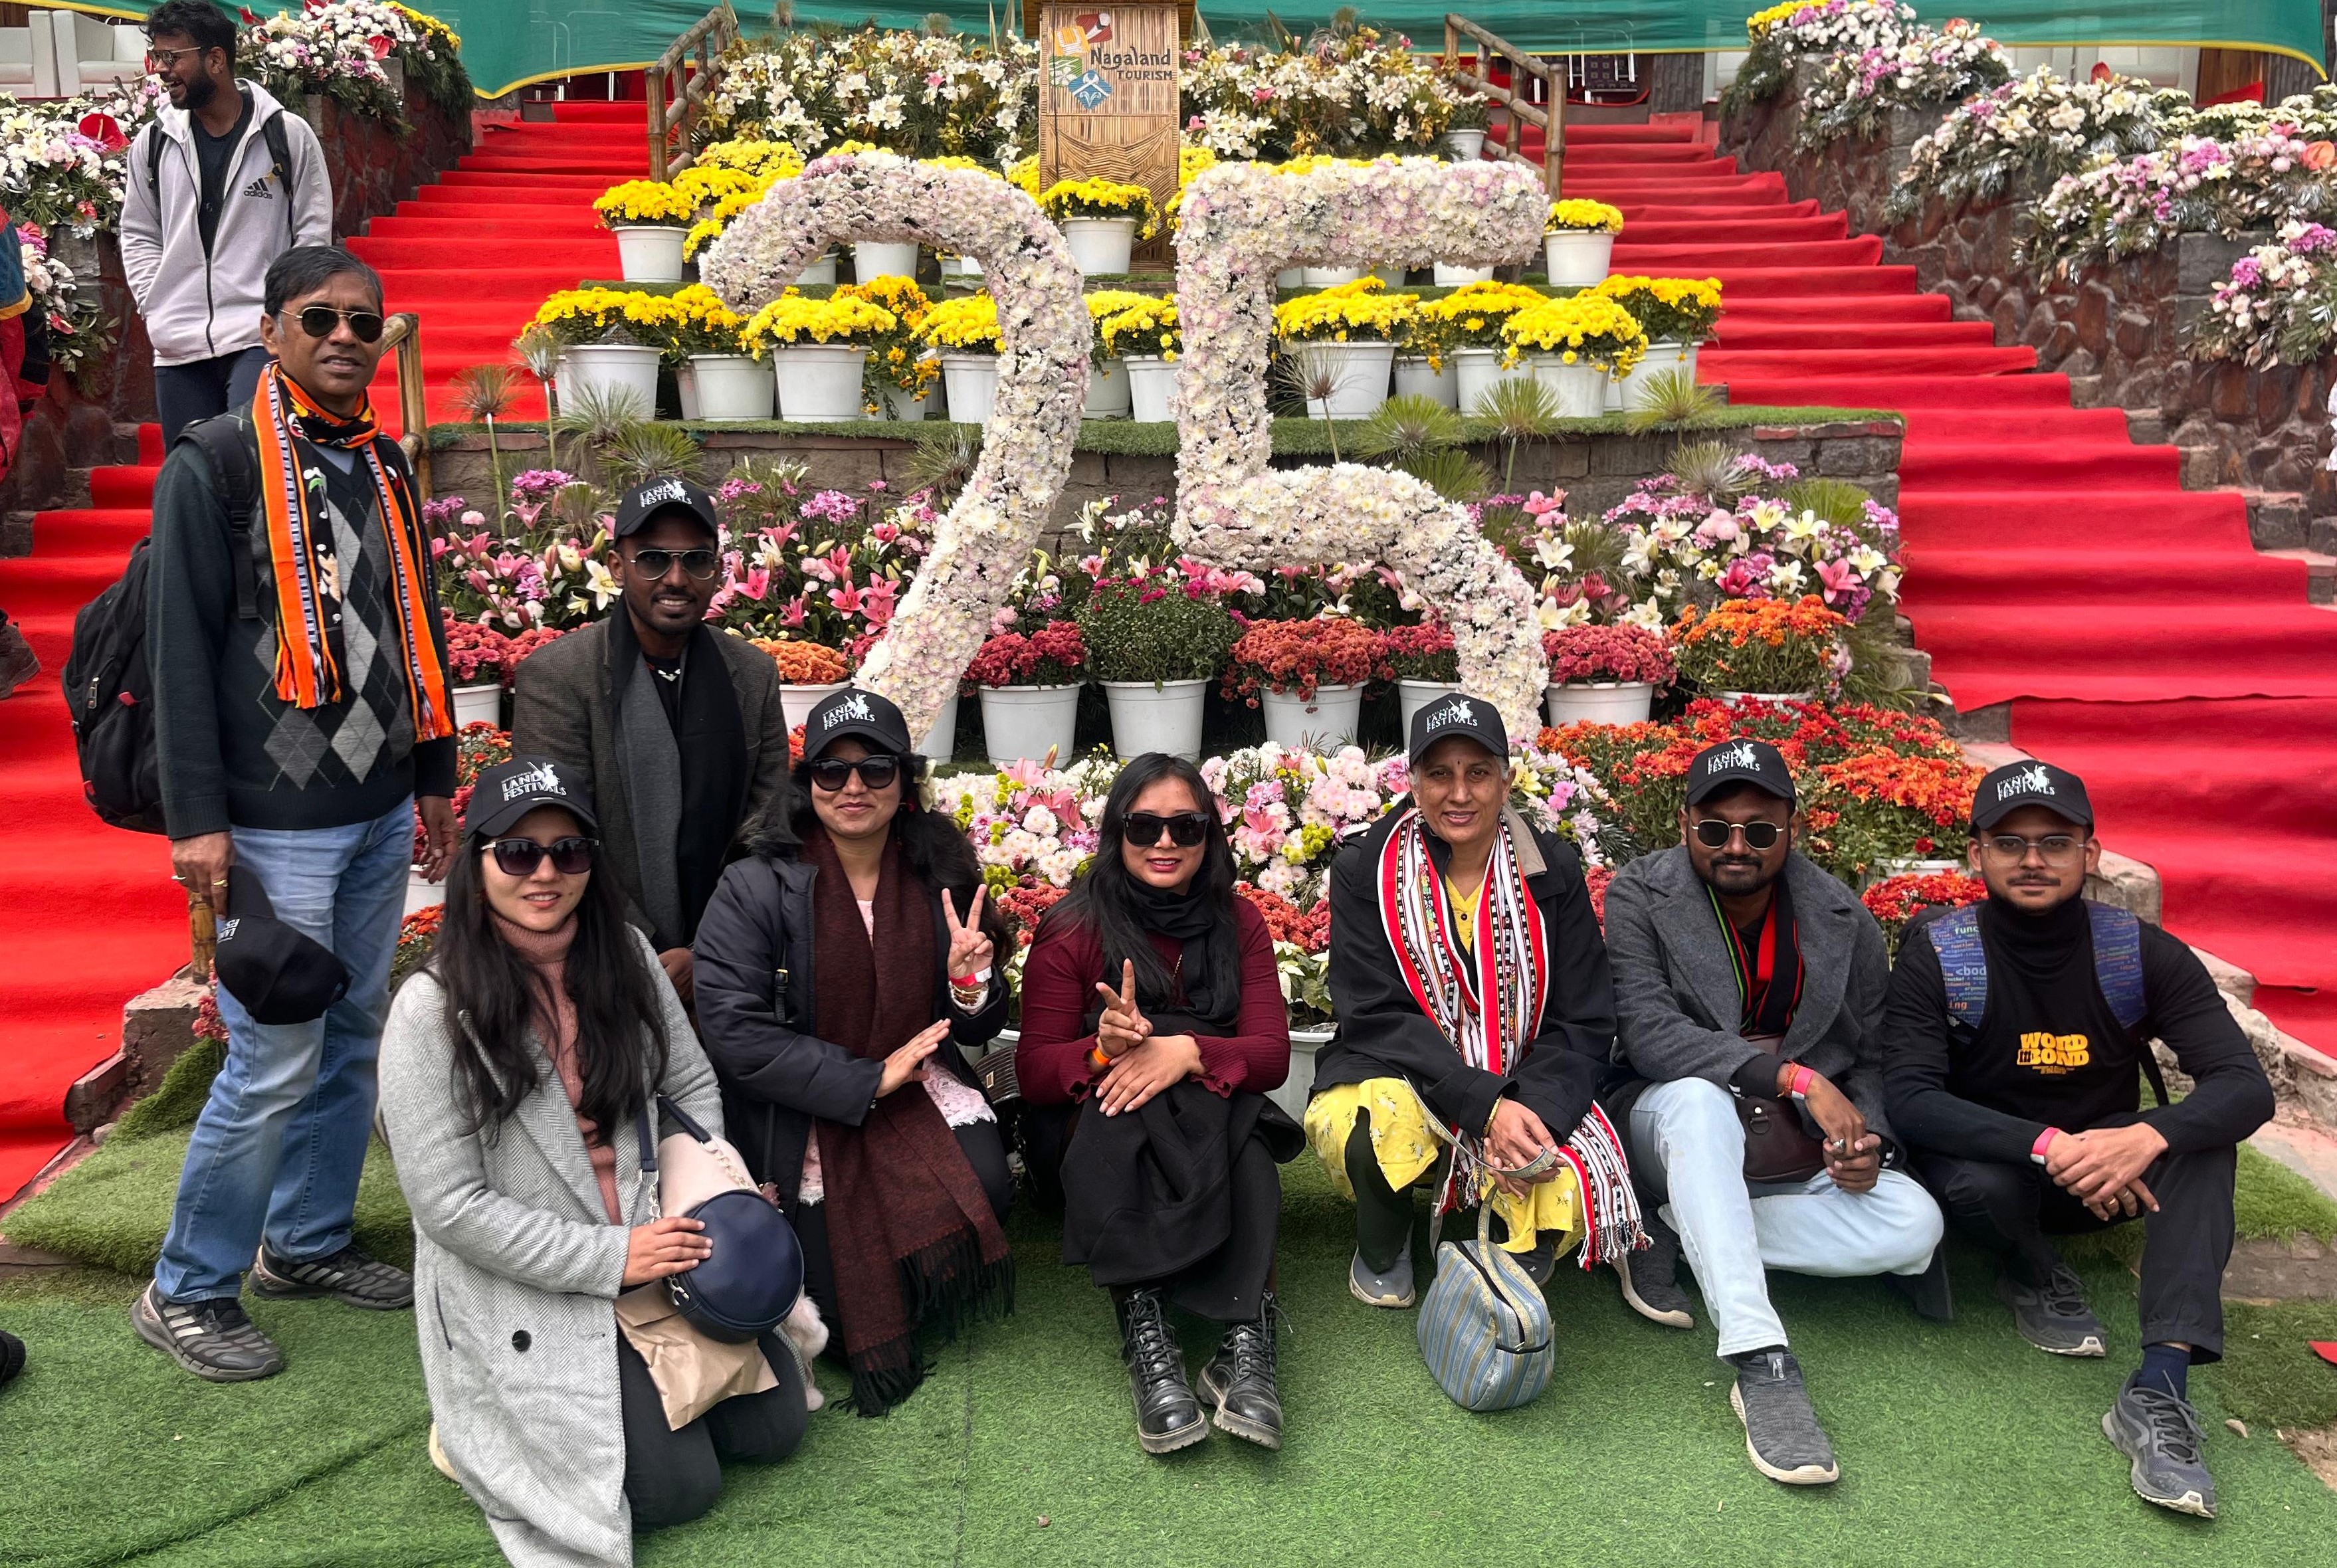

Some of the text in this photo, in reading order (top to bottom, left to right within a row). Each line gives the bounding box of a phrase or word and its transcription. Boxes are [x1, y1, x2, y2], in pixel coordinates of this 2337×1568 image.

[1090, 46, 1170, 70] Nagaland
[1117, 70, 1172, 80] TOURISM
[244, 189, 273, 199] adidas
[824, 711, 875, 730] FESTIVALS
[1427, 715, 1478, 733] FESTIVALS
[502, 773, 542, 792] LAND
[503, 781, 567, 801] FESTIVALS
[2020, 1032, 2088, 1052] WORD
[2029, 1048, 2089, 1066] BOND
